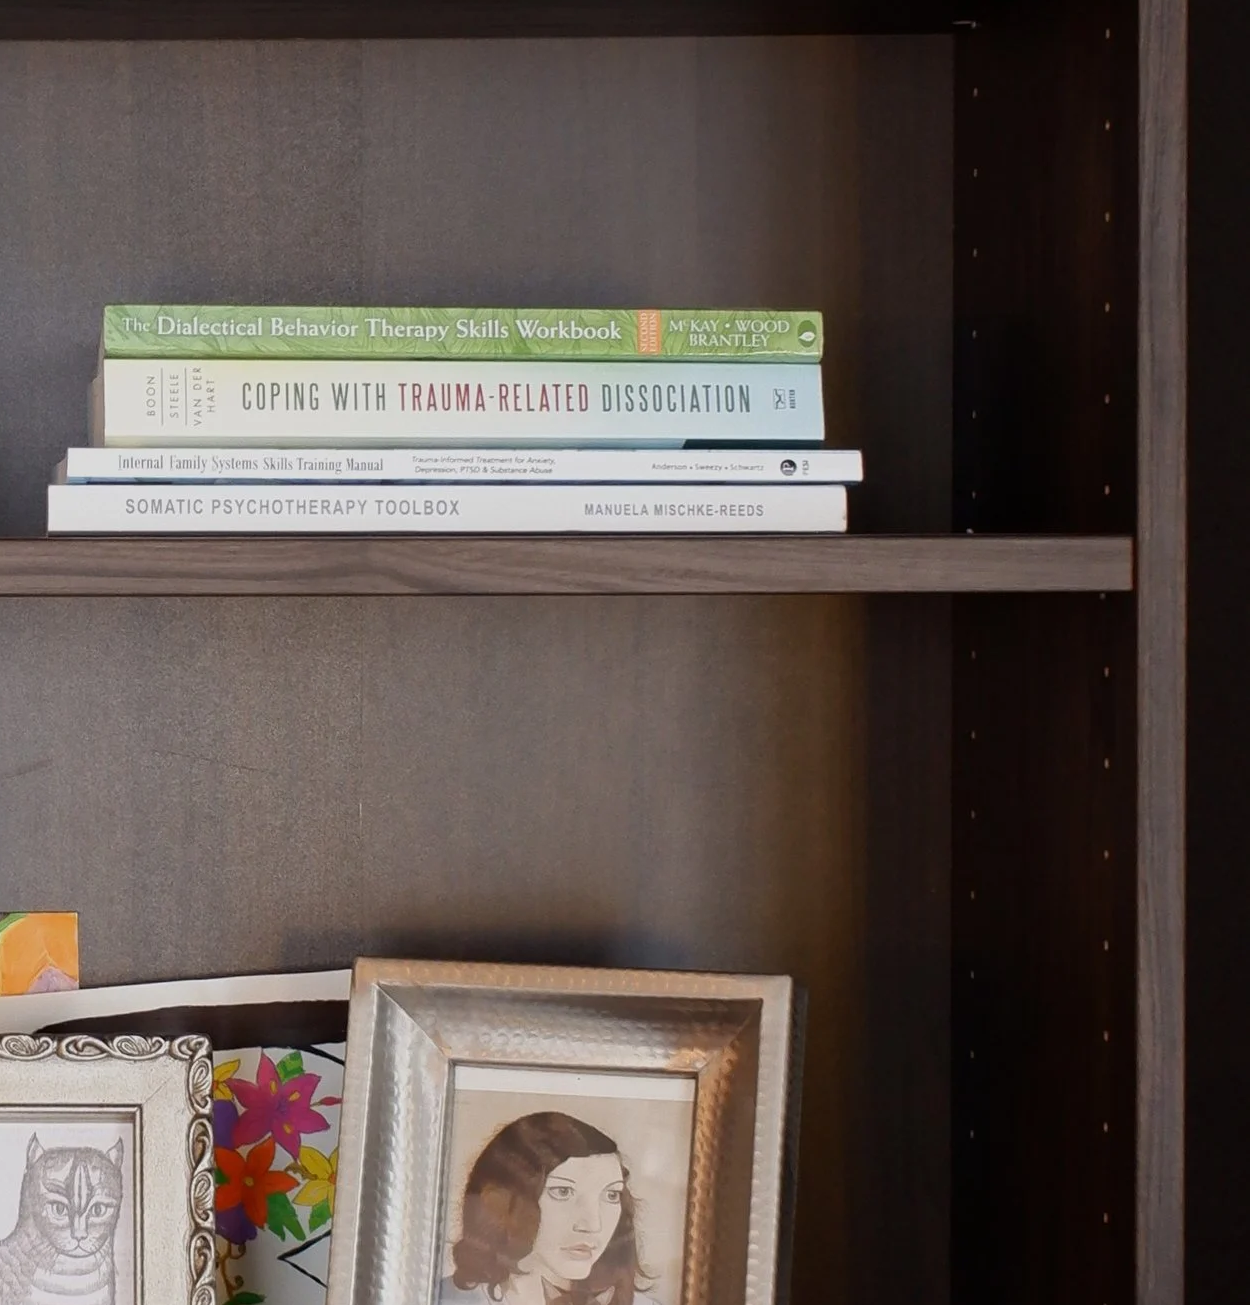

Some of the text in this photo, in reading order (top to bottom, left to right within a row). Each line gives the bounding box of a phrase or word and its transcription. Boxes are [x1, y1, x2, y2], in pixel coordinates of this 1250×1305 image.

[122, 314, 623, 348] The Dialectical Behavior Therapy Skills Workbook
[241, 381, 751, 414] COPING WITH TRAUMA-RELATED DISSOCIATION
[124, 497, 460, 517] SOMATIC PSYCHOTHERAPY TOOLBOX
[583, 502, 765, 518] MANUELA MISCHKE-REEDS
